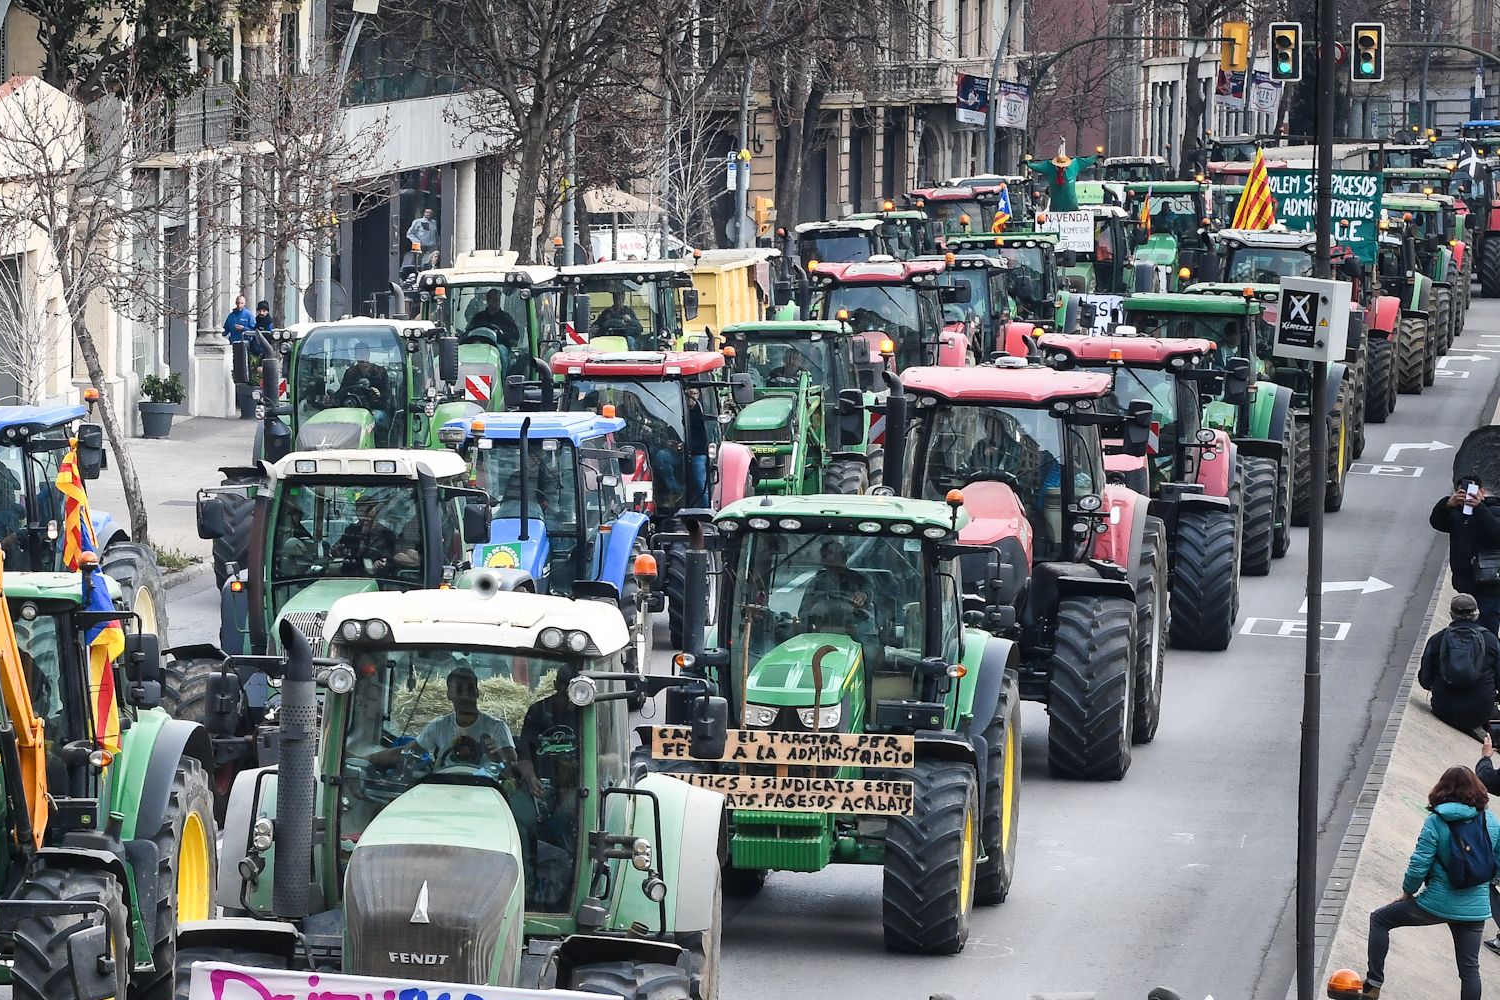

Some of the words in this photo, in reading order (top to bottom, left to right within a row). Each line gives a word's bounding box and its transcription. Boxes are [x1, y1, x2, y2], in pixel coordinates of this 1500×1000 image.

[1331, 174, 1378, 197] PAGESOS
[1056, 213, 1090, 223] VENDA
[1281, 321, 1314, 332] Ximenez
[738, 731, 758, 744] EL
[767, 733, 842, 746] TRACTOR
[732, 747, 748, 760] A
[756, 746, 778, 760] LA
[863, 781, 913, 796] ESTEU
[388, 951, 449, 965] FENDT
